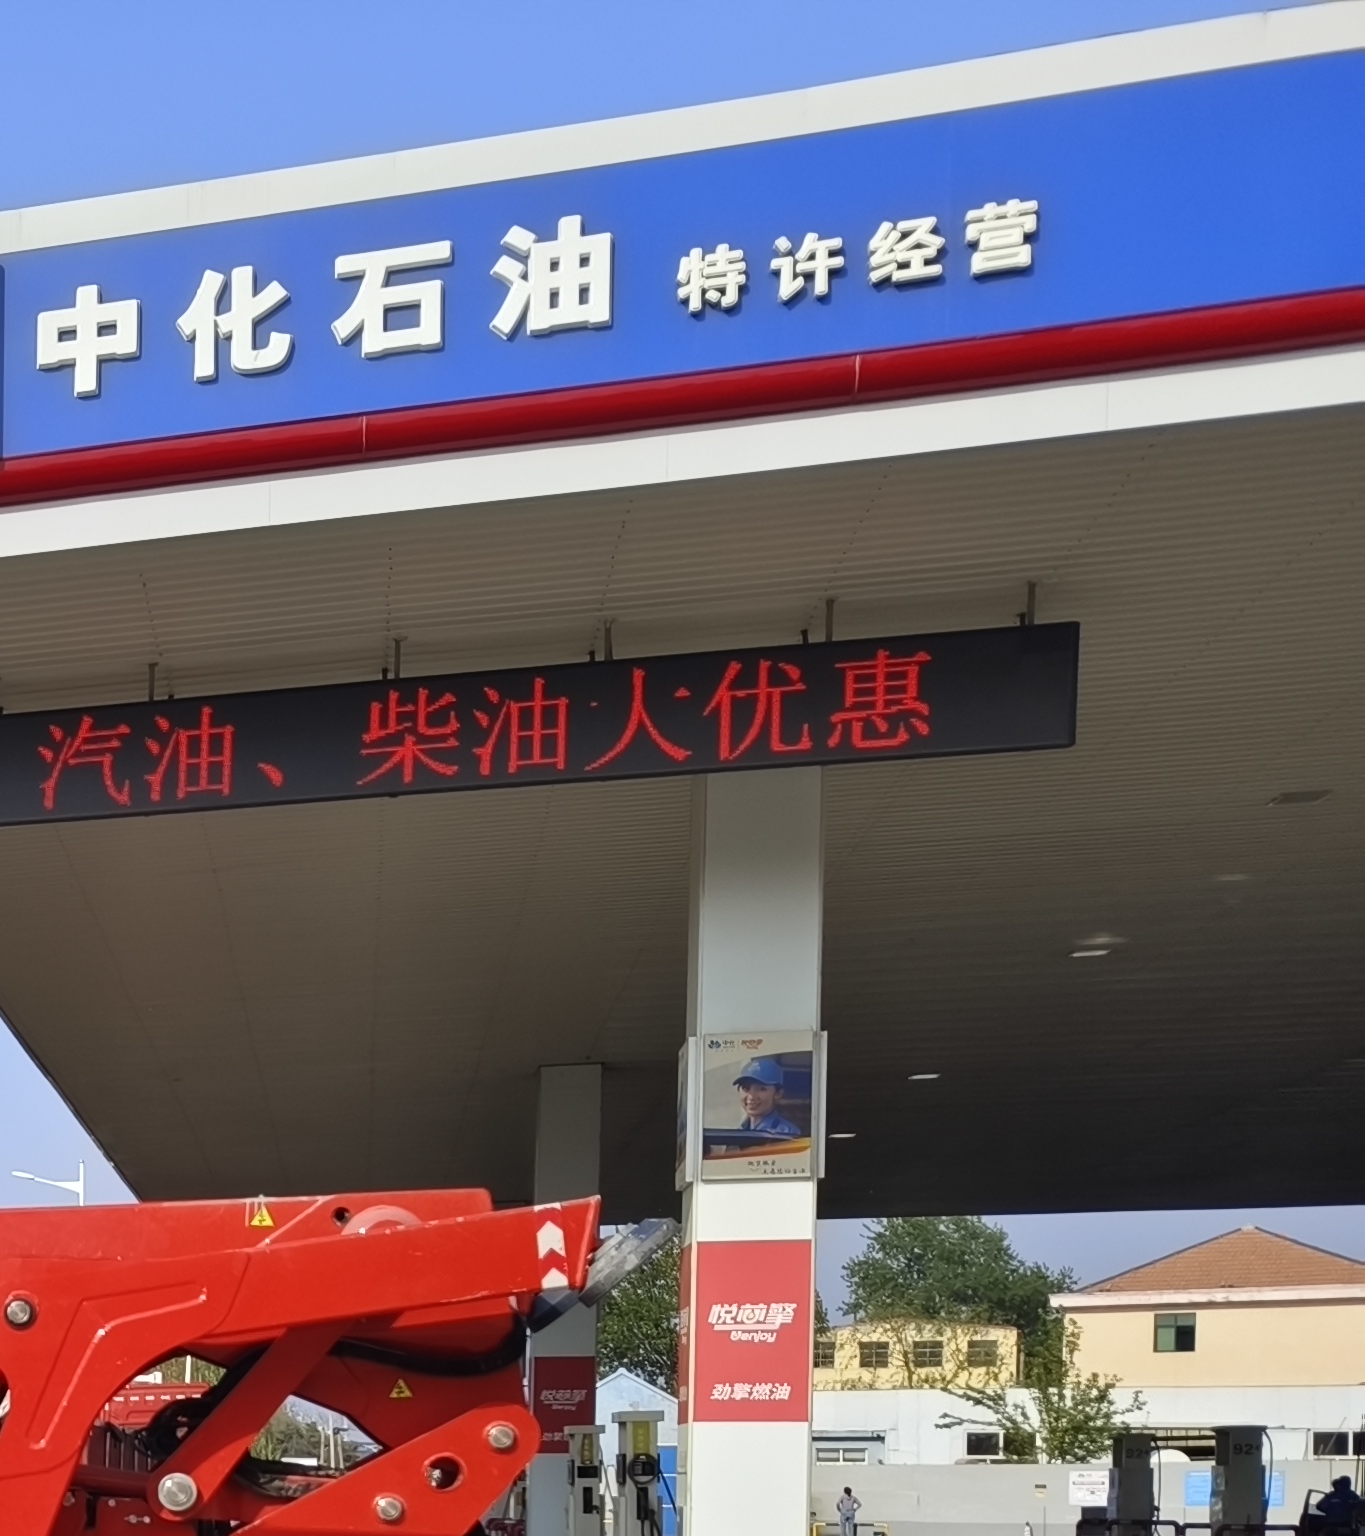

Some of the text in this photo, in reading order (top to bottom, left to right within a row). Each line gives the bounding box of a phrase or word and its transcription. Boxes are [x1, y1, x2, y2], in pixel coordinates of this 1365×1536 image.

[36, 197, 1040, 398] 中化石油 特许经营
[710, 1382, 792, 1401] 劲擎燃油
